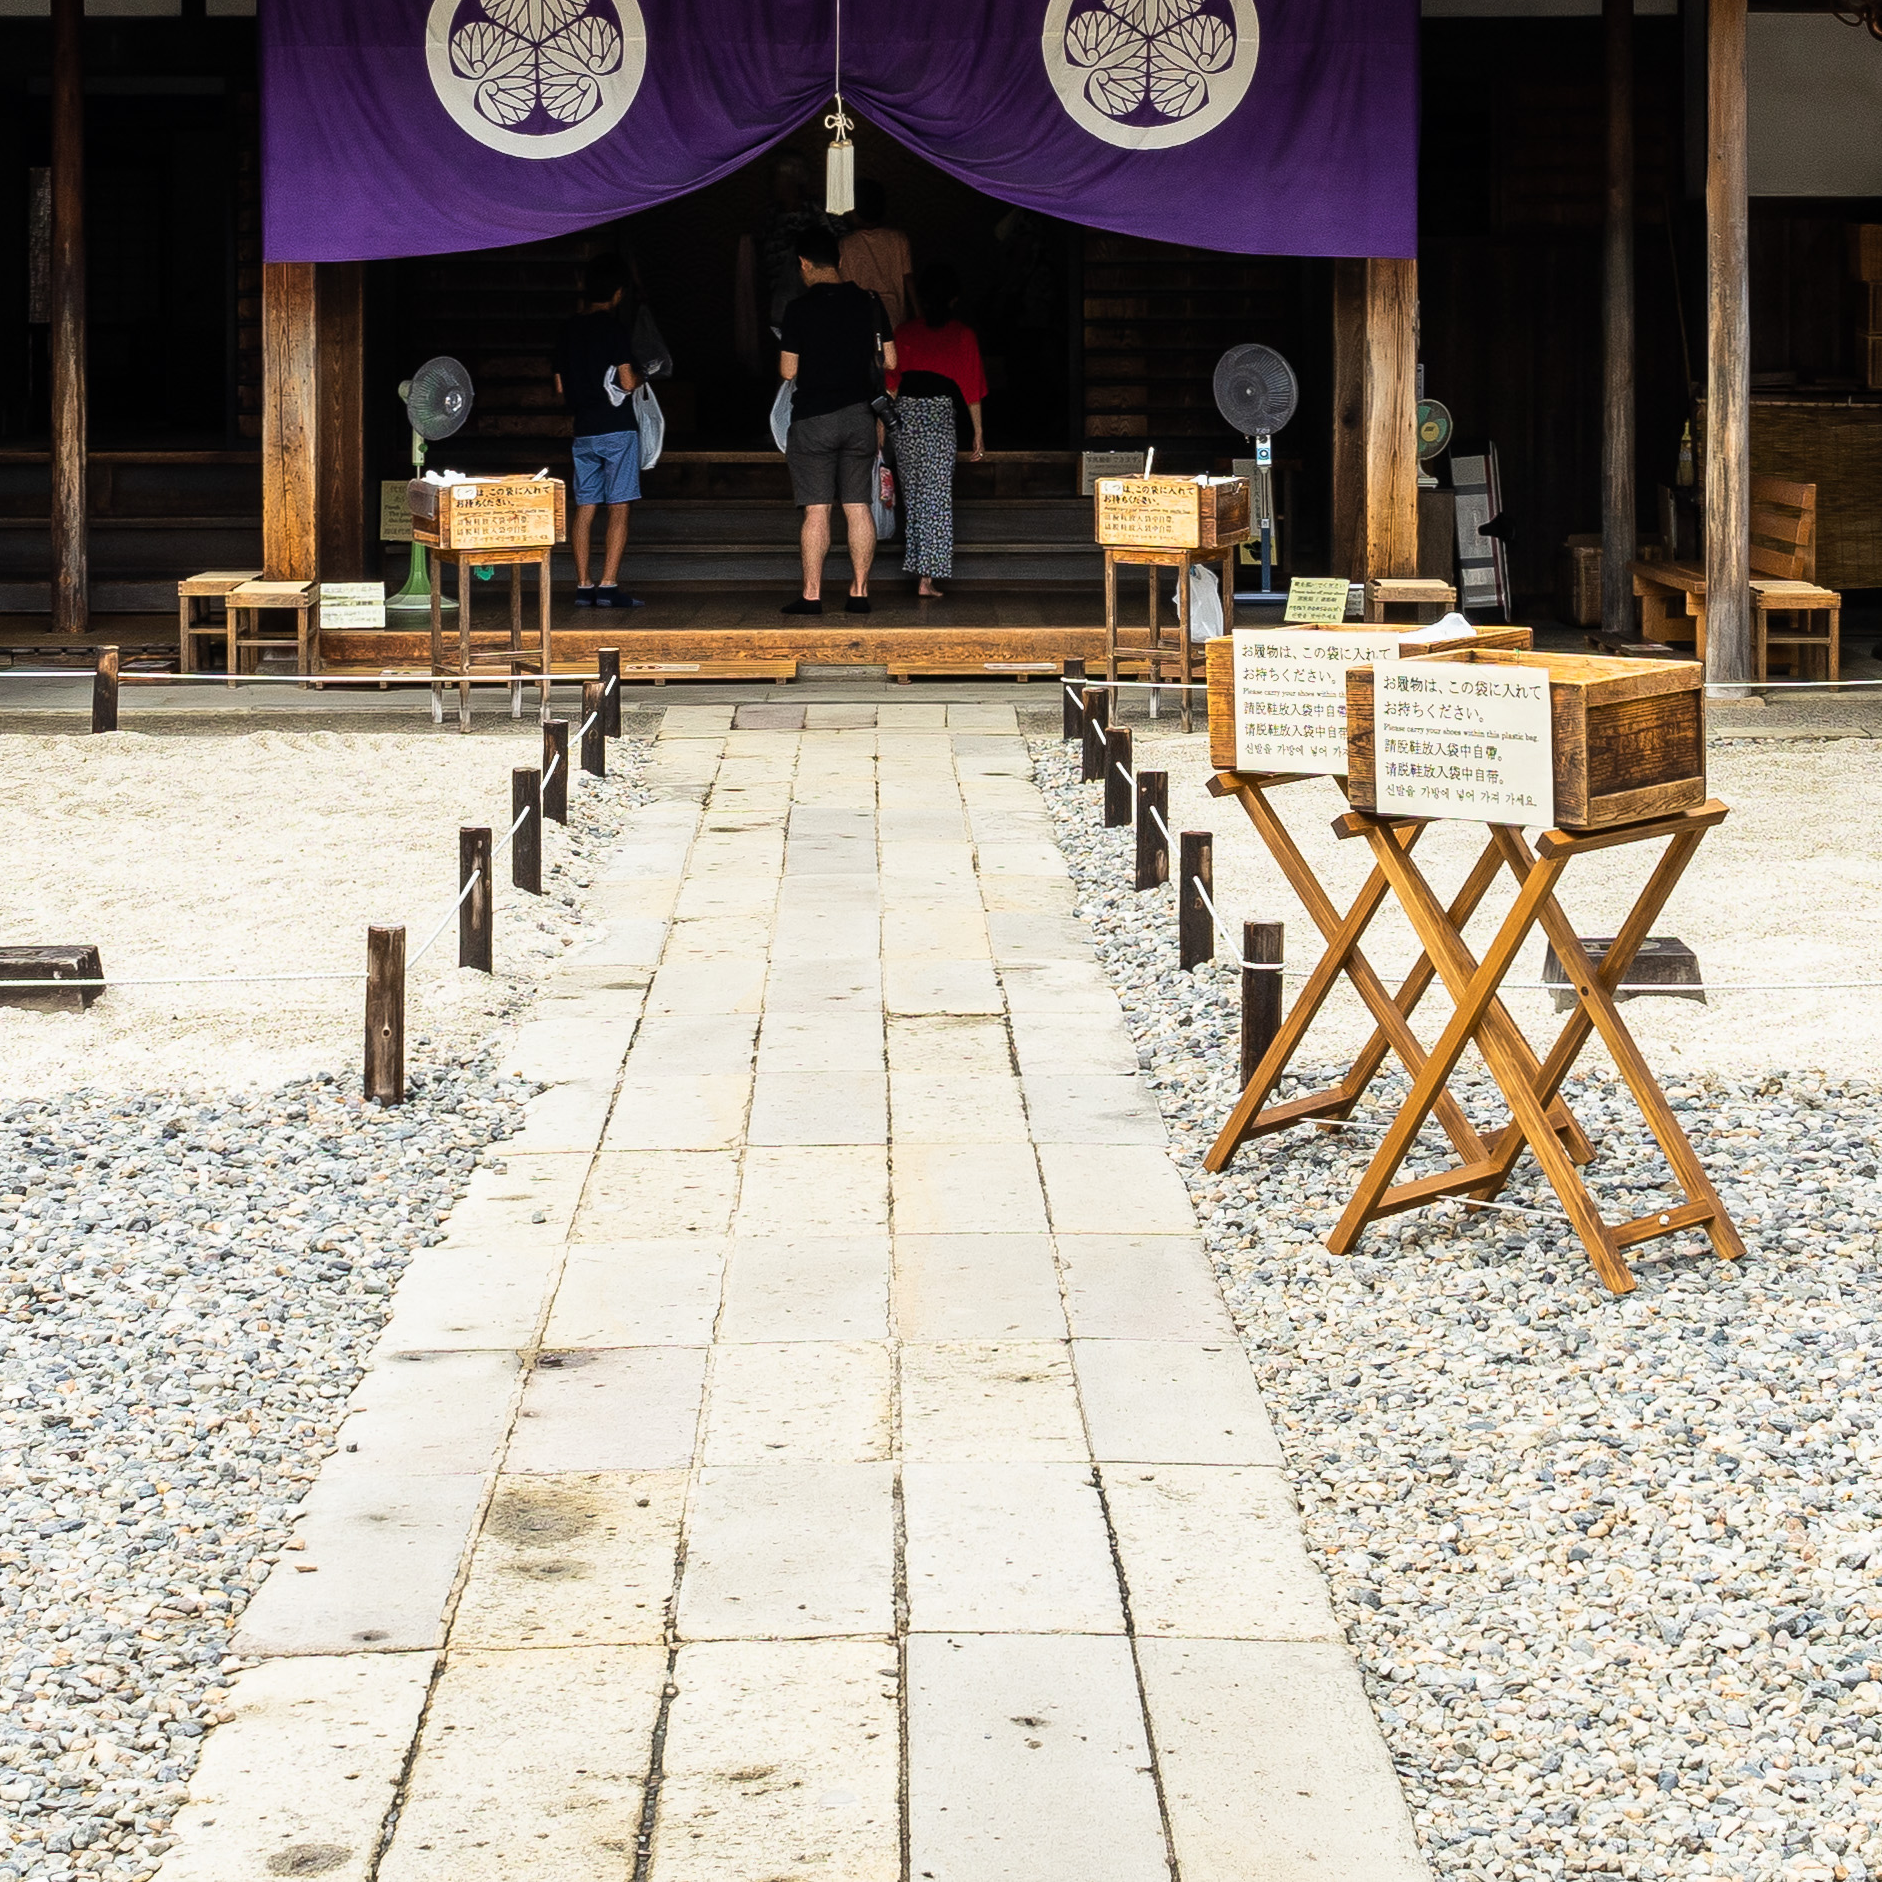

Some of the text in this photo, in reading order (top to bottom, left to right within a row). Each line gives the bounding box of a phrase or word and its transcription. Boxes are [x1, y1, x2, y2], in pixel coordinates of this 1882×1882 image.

[1242, 667, 1336, 684] お持ちください。
[1384, 675, 1541, 700] お履物は、この袋に入れて
[1384, 701, 1485, 722] お持ちください。
[1384, 723, 1406, 733] Please
[1407, 726, 1424, 734] carry
[1426, 727, 1441, 736] your
[1443, 727, 1462, 736] shoes
[1463, 729, 1485, 738] within
[1486, 730, 1500, 739] this
[1502, 731, 1524, 741] plastic
